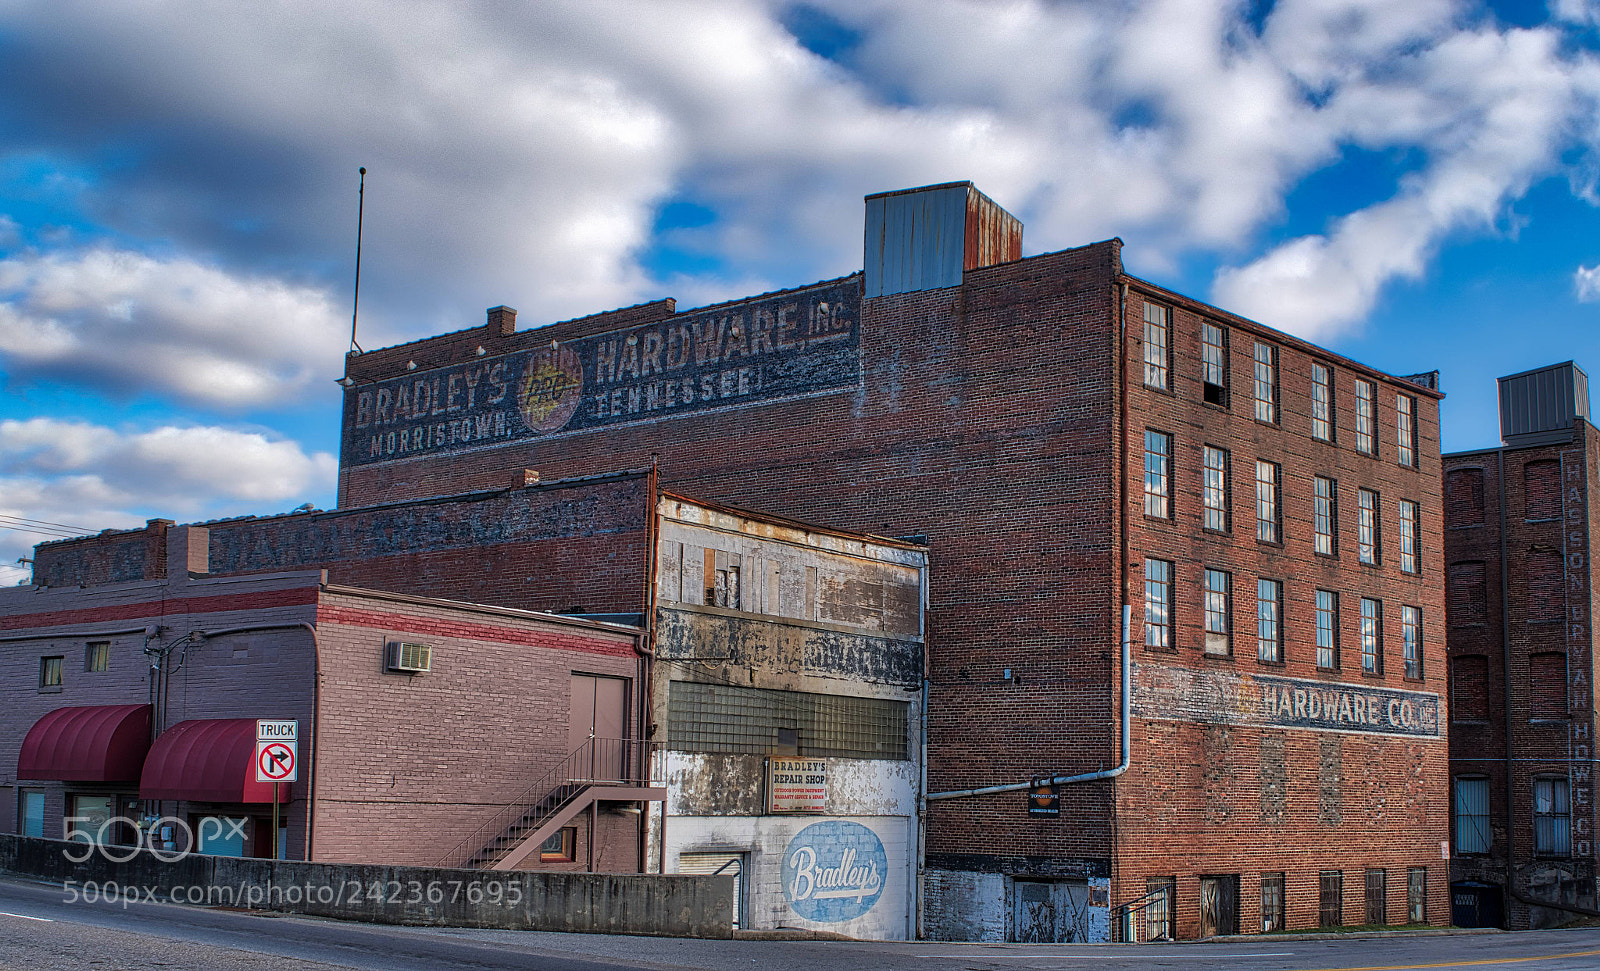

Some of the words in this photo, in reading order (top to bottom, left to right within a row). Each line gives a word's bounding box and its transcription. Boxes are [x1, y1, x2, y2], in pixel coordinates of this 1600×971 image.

[356, 362, 507, 429] BRADLEY'S
[596, 303, 799, 384] HARDWARE
[1263, 684, 1379, 725] HARDWARE
[260, 724, 295, 736] TRUCK
[773, 774, 803, 784] REPAIR
[805, 774, 825, 784] SHOP
[774, 761, 826, 772] BRADLEY'S
[789, 847, 881, 904] Bradley's
